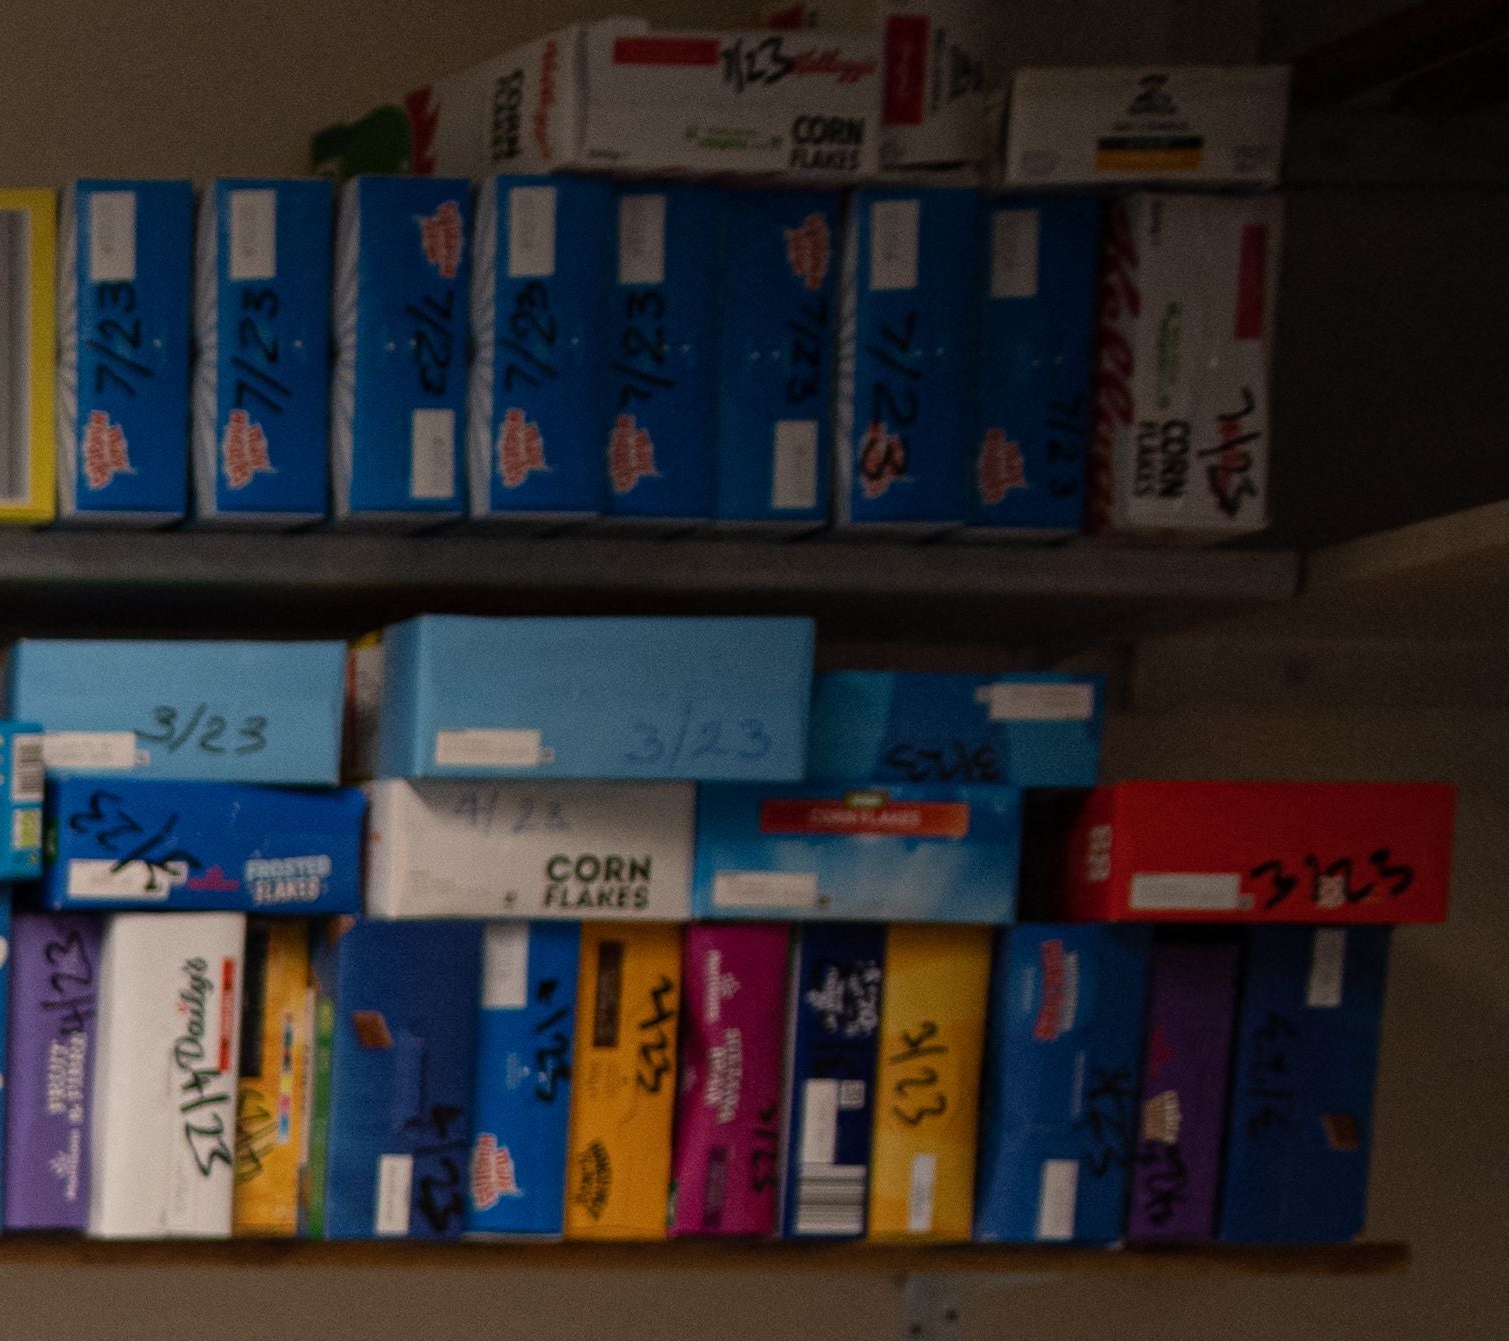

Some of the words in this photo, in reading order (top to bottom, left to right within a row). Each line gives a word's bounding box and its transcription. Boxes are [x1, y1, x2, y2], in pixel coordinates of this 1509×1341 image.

[790, 114, 865, 147] CORN
[789, 145, 861, 171] FLAKES
[94, 281, 156, 398] 7/23
[231, 283, 285, 415] 7/23
[498, 280, 560, 394] 7/23
[1133, 421, 1155, 498] FLAKES
[1159, 421, 1190, 498] CORN
[134, 702, 270, 755] 3/23
[625, 701, 773, 764] 3/23
[245, 856, 331, 881] FROSTED
[253, 879, 322, 904] FLAKES
[546, 855, 652, 883] CORN
[543, 885, 649, 910] FLAKES
